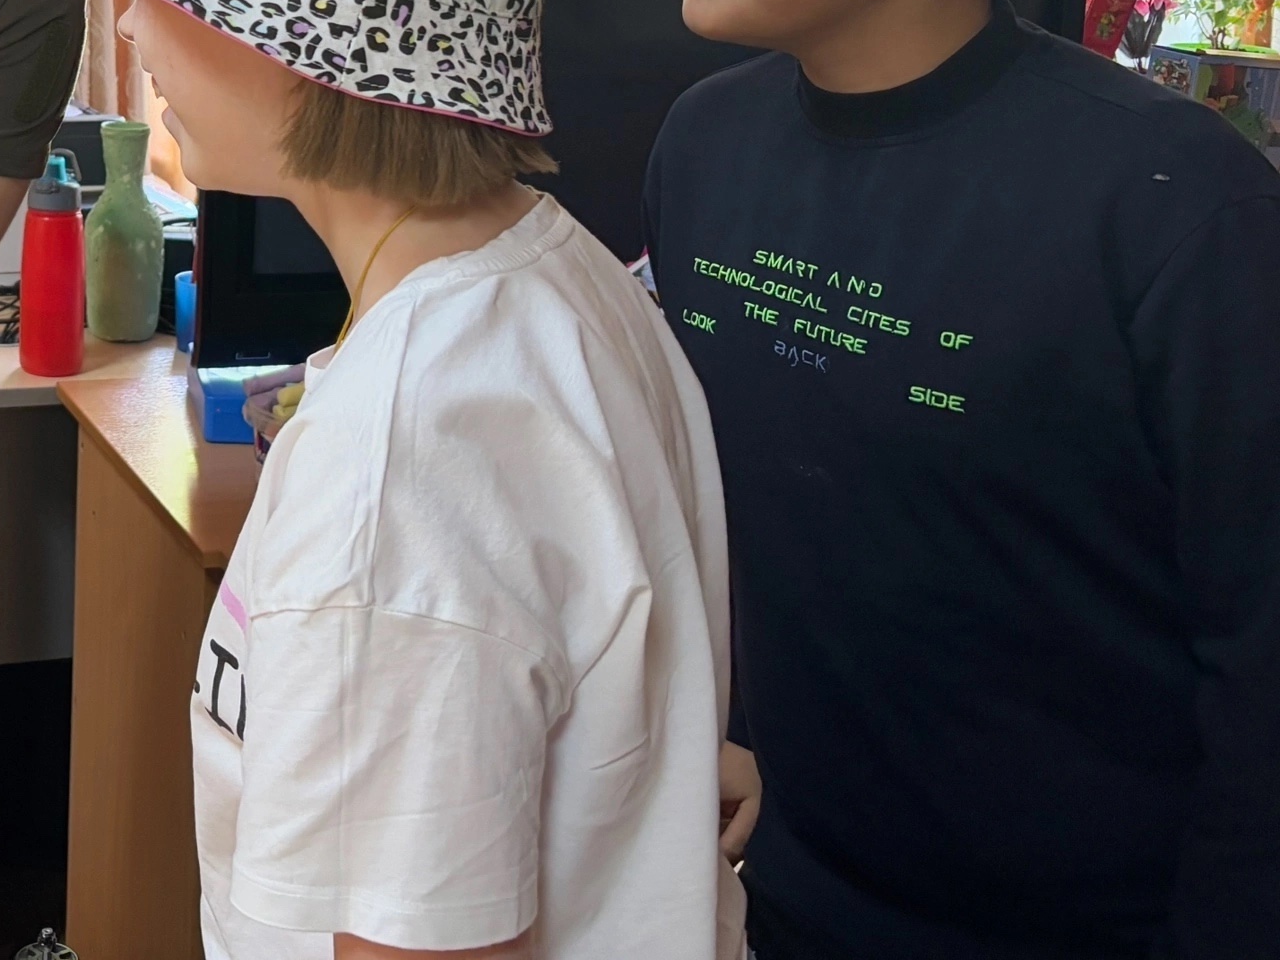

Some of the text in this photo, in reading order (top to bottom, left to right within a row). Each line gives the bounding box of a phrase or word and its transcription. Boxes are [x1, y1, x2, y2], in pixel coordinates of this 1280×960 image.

[693, 257, 974, 350] TECHNOLOGICAL CITES OF
[753, 250, 882, 297] SMART AND
[682, 309, 966, 414] LOOK BACK SIDE
[744, 302, 868, 355] THE FUTURE
